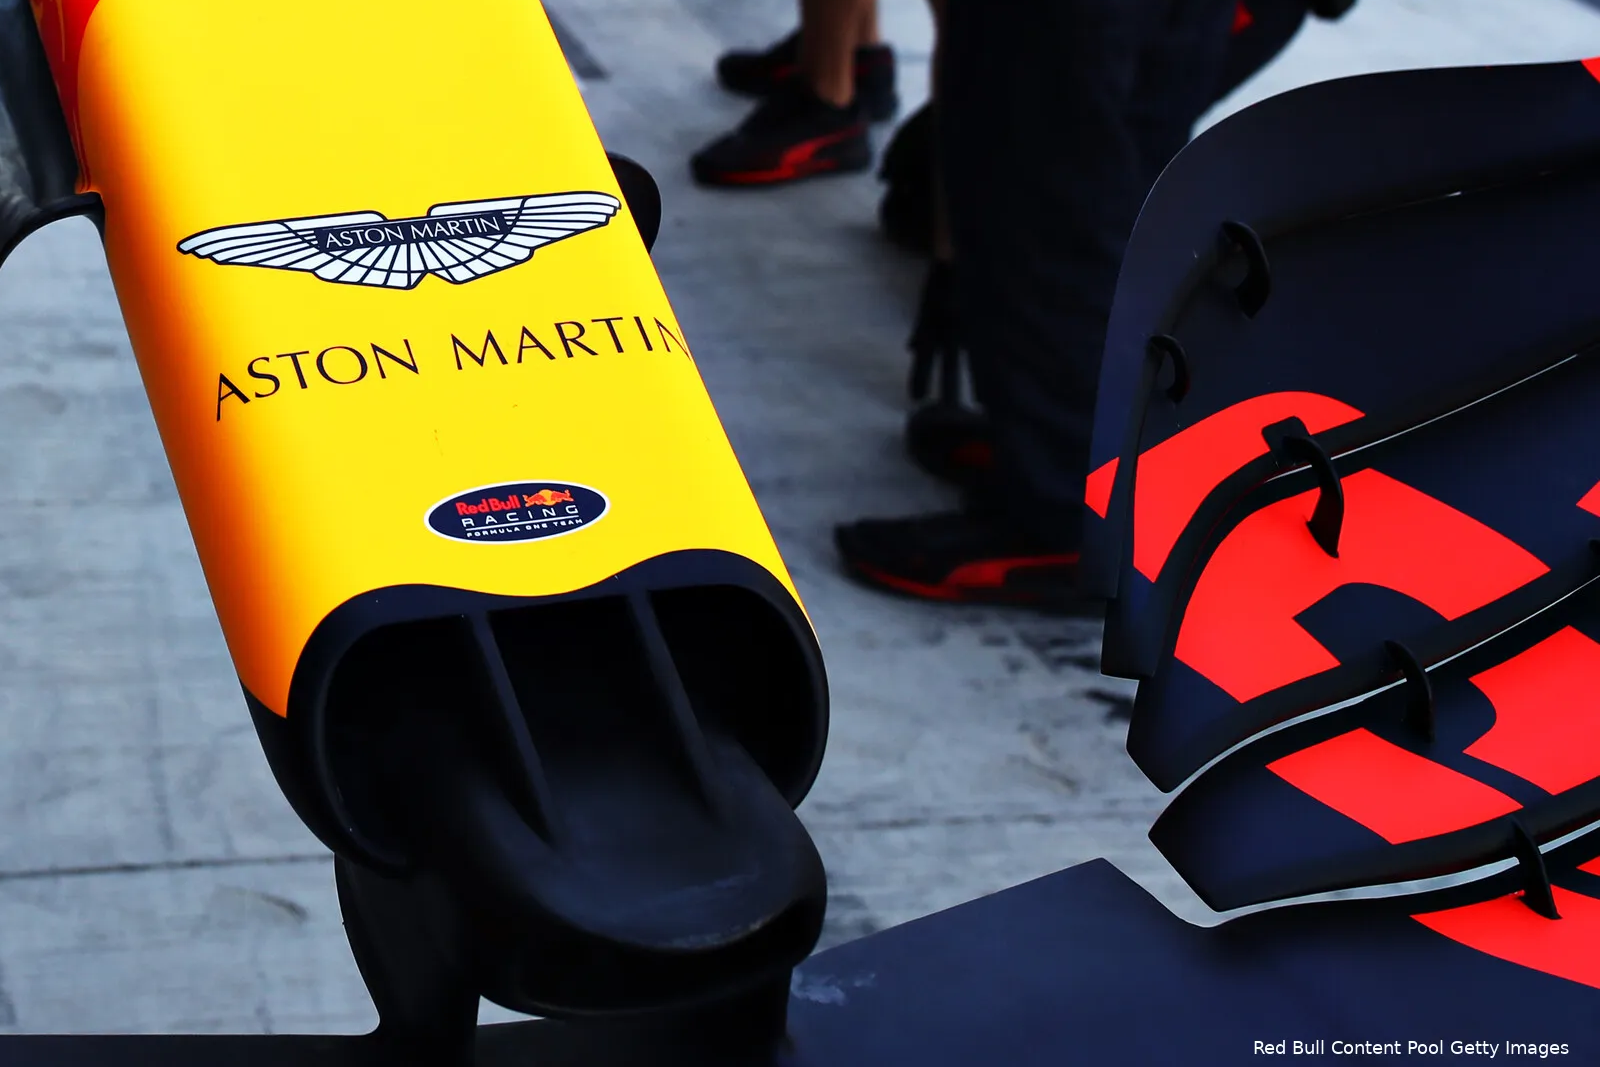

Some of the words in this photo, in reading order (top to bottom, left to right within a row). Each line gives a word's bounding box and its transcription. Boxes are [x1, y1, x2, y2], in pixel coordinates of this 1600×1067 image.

[325, 225, 404, 249] ASTON
[410, 216, 501, 240] MARTIN
[216, 337, 420, 422] ASTON
[450, 315, 692, 371] MARTIN
[461, 504, 579, 528] RACING
[466, 526, 521, 538] FORMULA
[525, 522, 548, 531] ONE
[552, 518, 583, 527] TEAM
